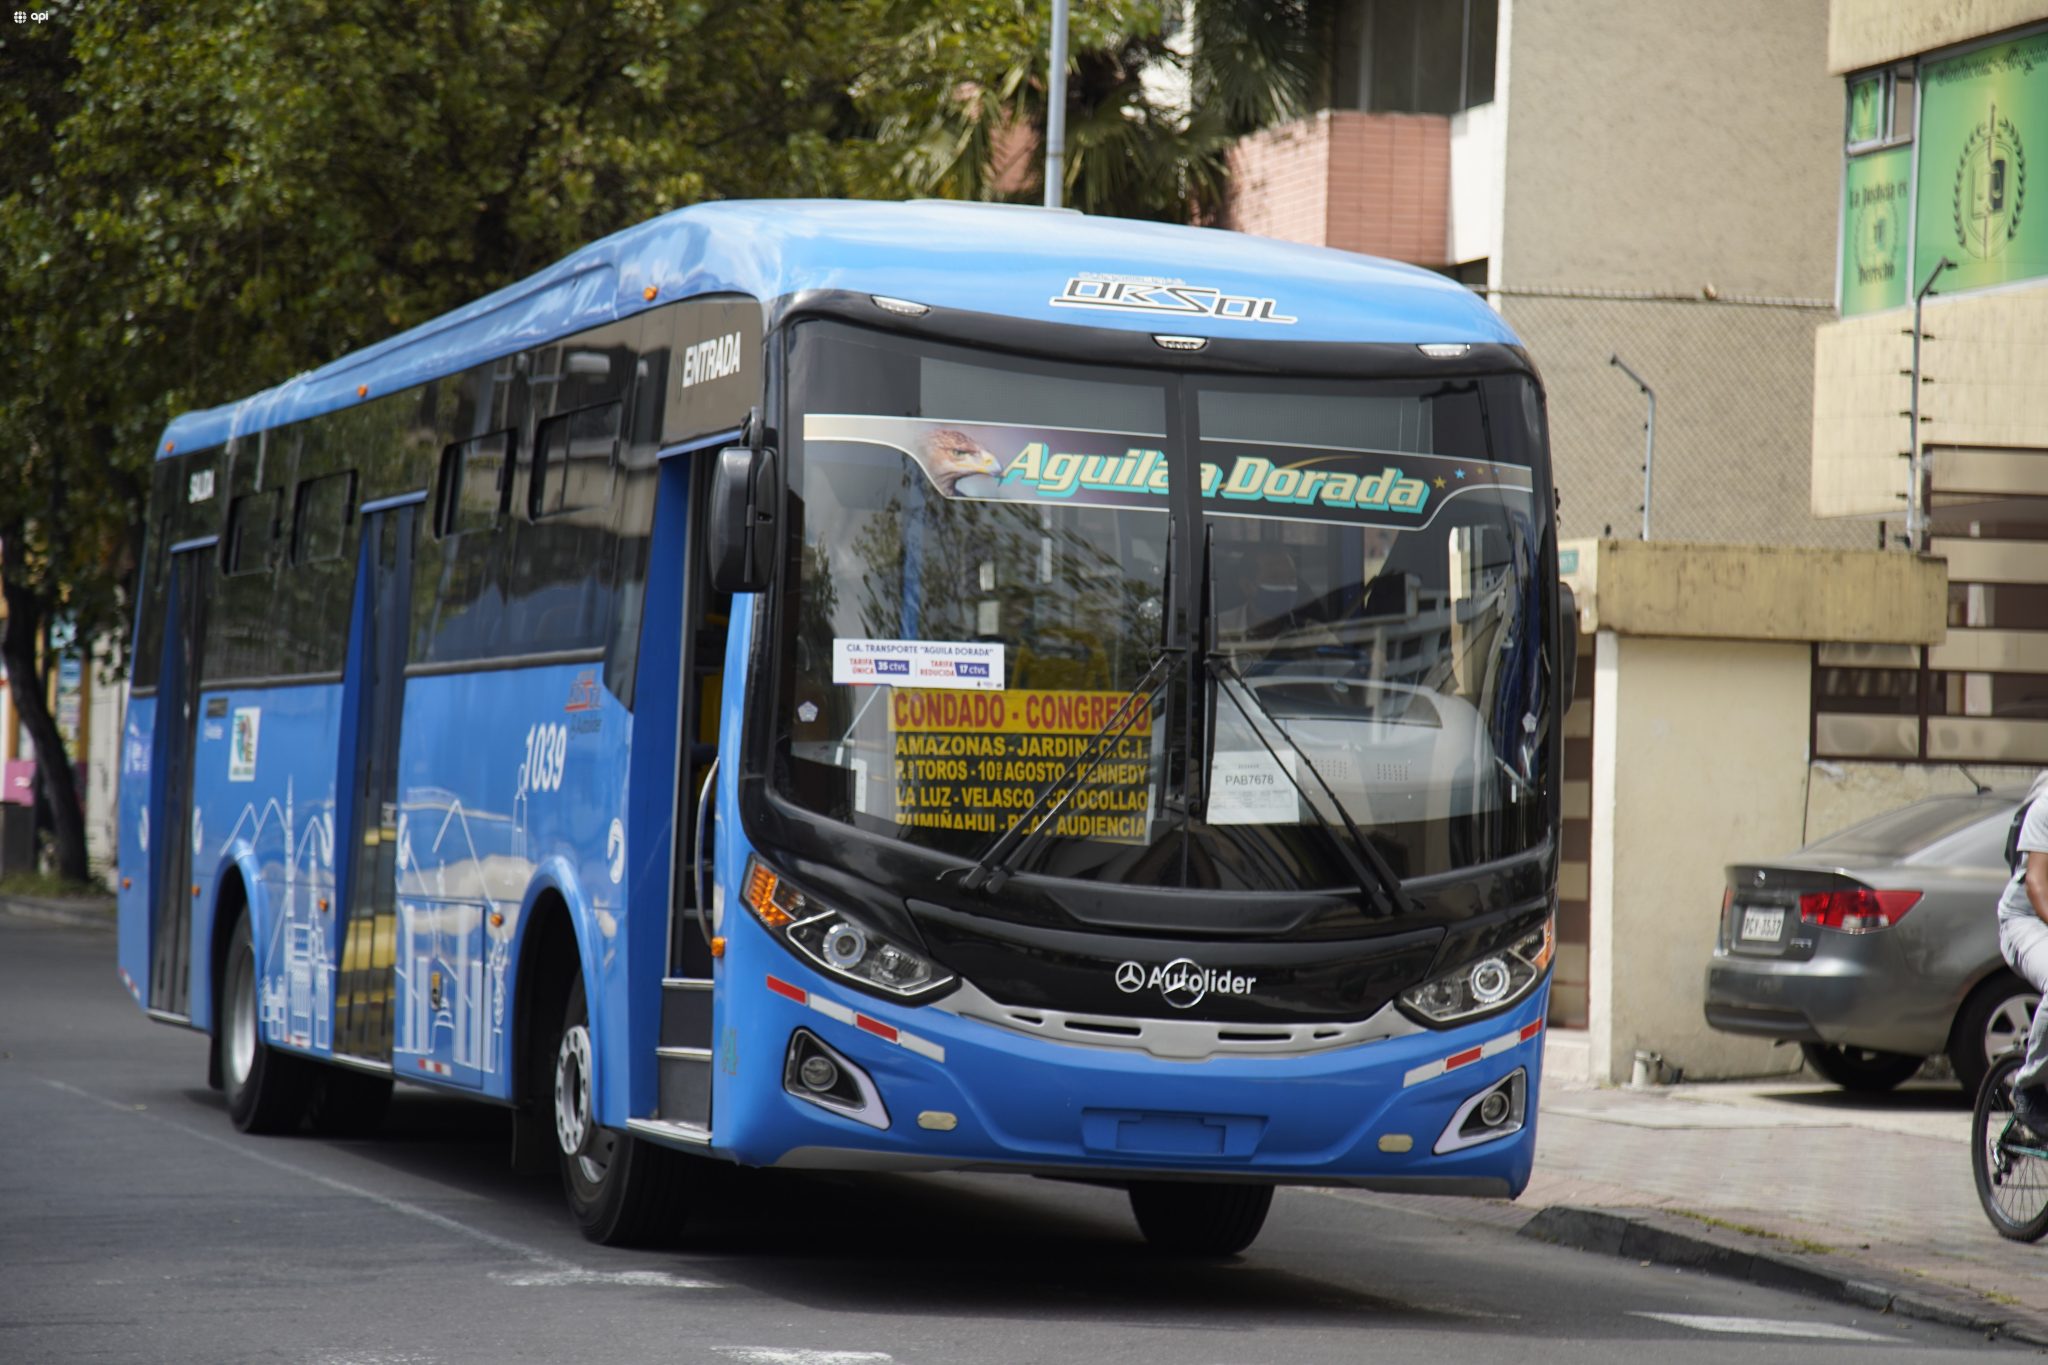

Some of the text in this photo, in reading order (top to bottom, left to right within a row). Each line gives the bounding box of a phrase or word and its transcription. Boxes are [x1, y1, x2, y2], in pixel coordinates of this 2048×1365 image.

[682, 331, 741, 388] ENTRADA
[1221, 456, 1430, 514] Dorada
[846, 644, 862, 652] CIA.
[866, 645, 918, 654] TRANSPORTE
[878, 661, 889, 671] 35
[931, 660, 953, 668] TARIFA
[959, 665, 968, 674] 17
[920, 669, 954, 677] REDUCIDA
[894, 692, 1005, 729] CONDADO
[525, 721, 567, 793] 1039
[895, 735, 1005, 757] AMAZONAS
[1225, 774, 1274, 786] PAB7678
[895, 787, 916, 807] LA
[920, 787, 952, 807] LUZ
[961, 787, 1035, 809] VELASCO
[1056, 815, 1147, 836] AUDIENCIA
[1147, 966, 1256, 994] Autolider
